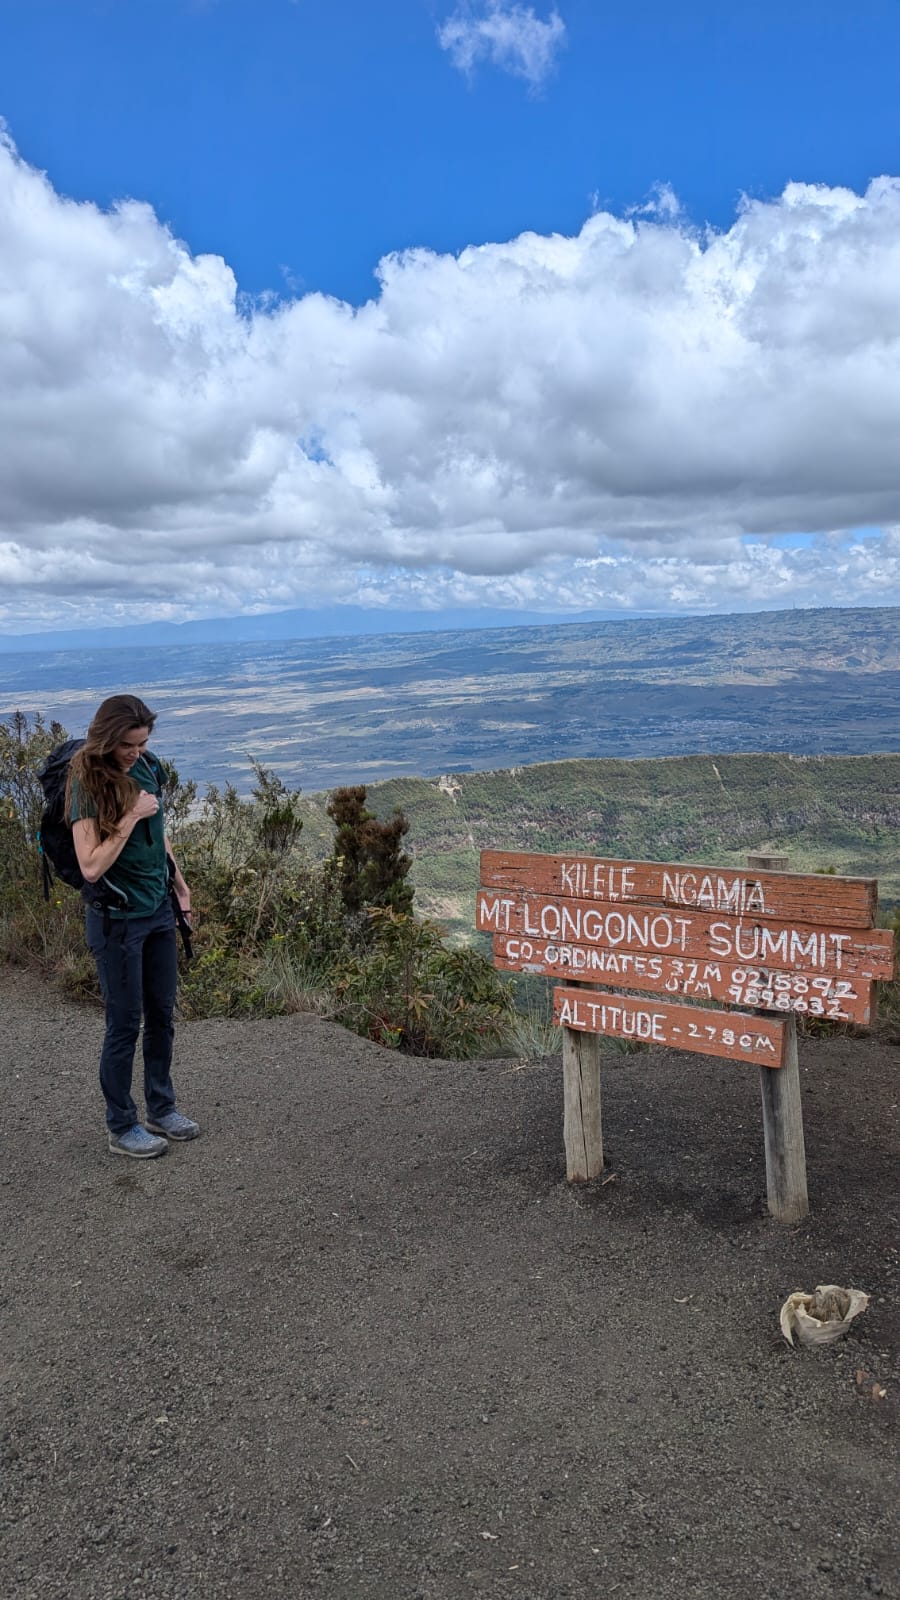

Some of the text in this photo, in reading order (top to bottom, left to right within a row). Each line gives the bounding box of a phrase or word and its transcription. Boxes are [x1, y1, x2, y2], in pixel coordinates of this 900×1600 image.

[480, 898, 852, 970] MT LONGONOT SUMMIT
[506, 940, 663, 979] CO-ORDINATES
[559, 998, 668, 1042] ALTITUDE
